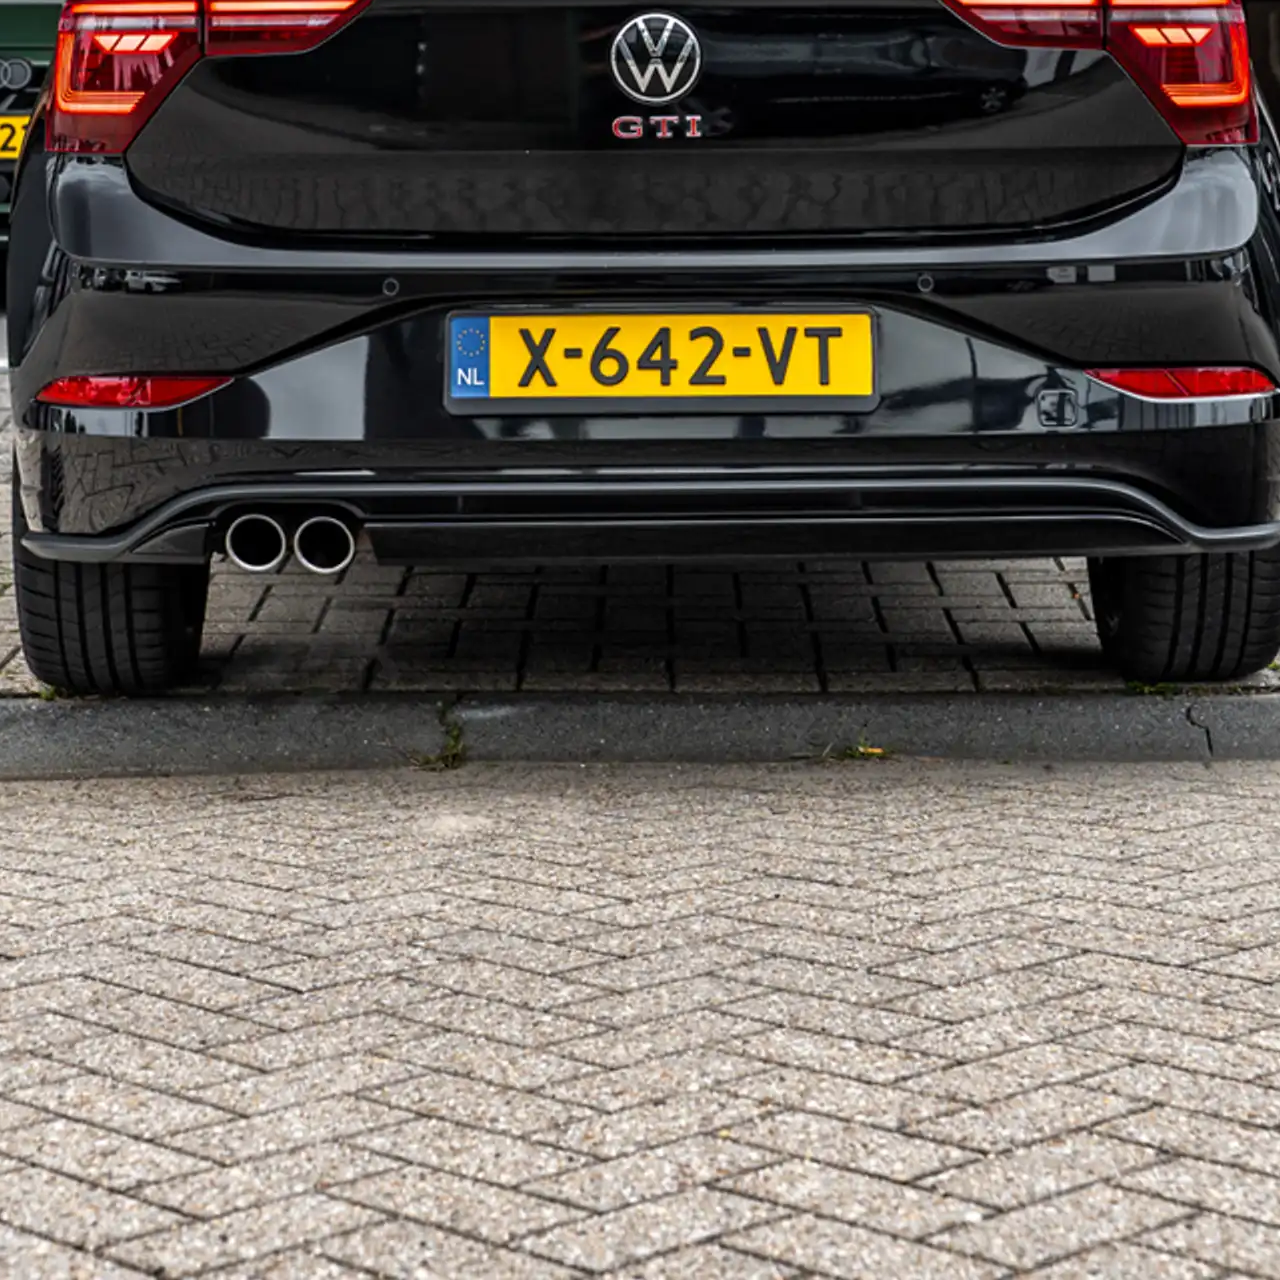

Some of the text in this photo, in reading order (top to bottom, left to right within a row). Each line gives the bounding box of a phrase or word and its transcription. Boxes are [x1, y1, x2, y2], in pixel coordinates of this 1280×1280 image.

[612, 115, 702, 138] GTI
[518, 326, 843, 388] X-642-VT
[457, 368, 484, 386] NL
